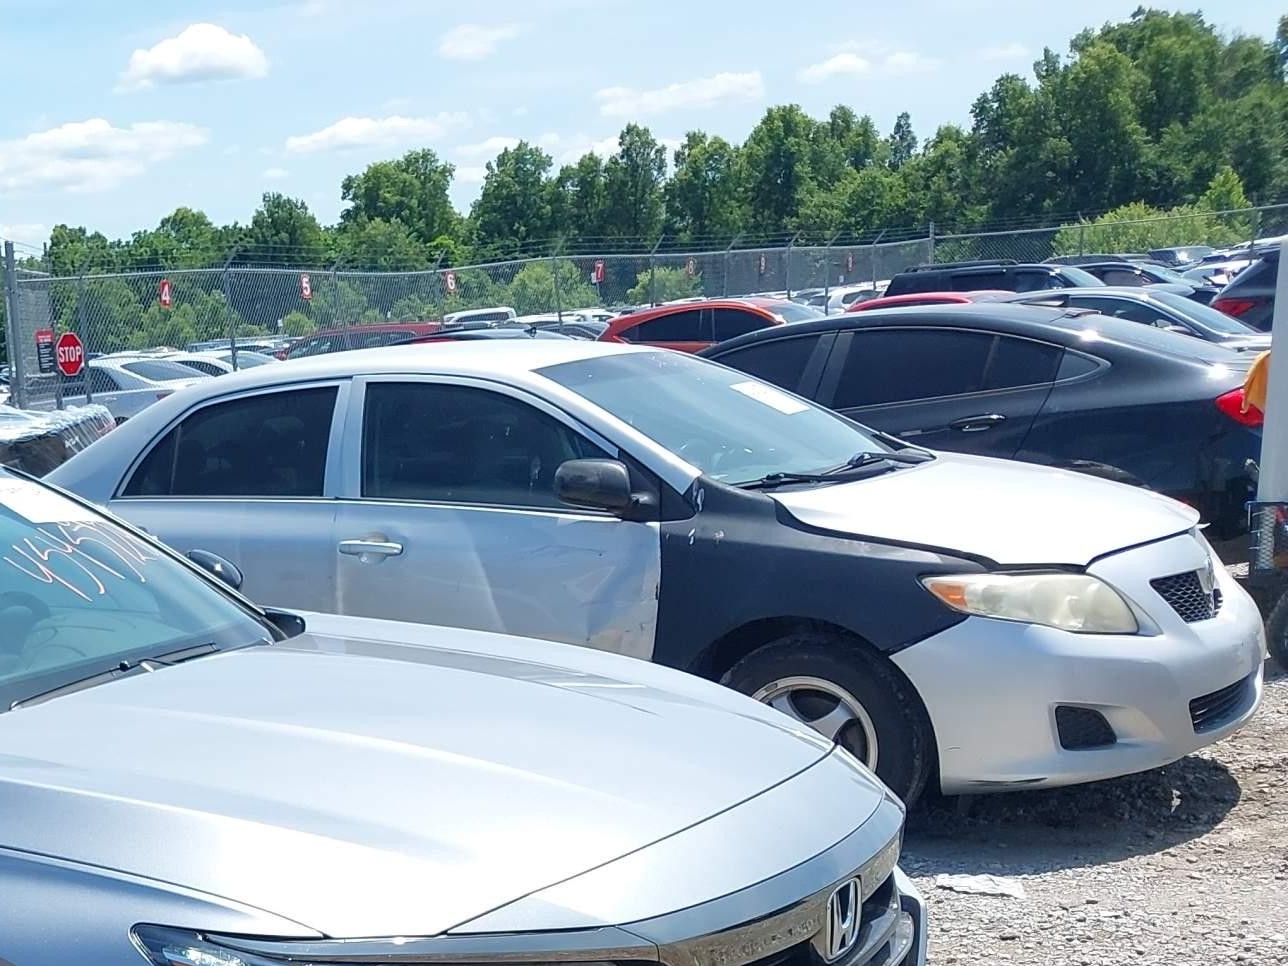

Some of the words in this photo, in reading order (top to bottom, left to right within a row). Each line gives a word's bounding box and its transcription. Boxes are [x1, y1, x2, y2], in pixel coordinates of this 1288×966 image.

[596, 262, 604, 279] 7
[301, 276, 311, 295] 5
[447, 274, 456, 290] 6
[162, 284, 170, 305] 4
[59, 346, 82, 362] STOP
